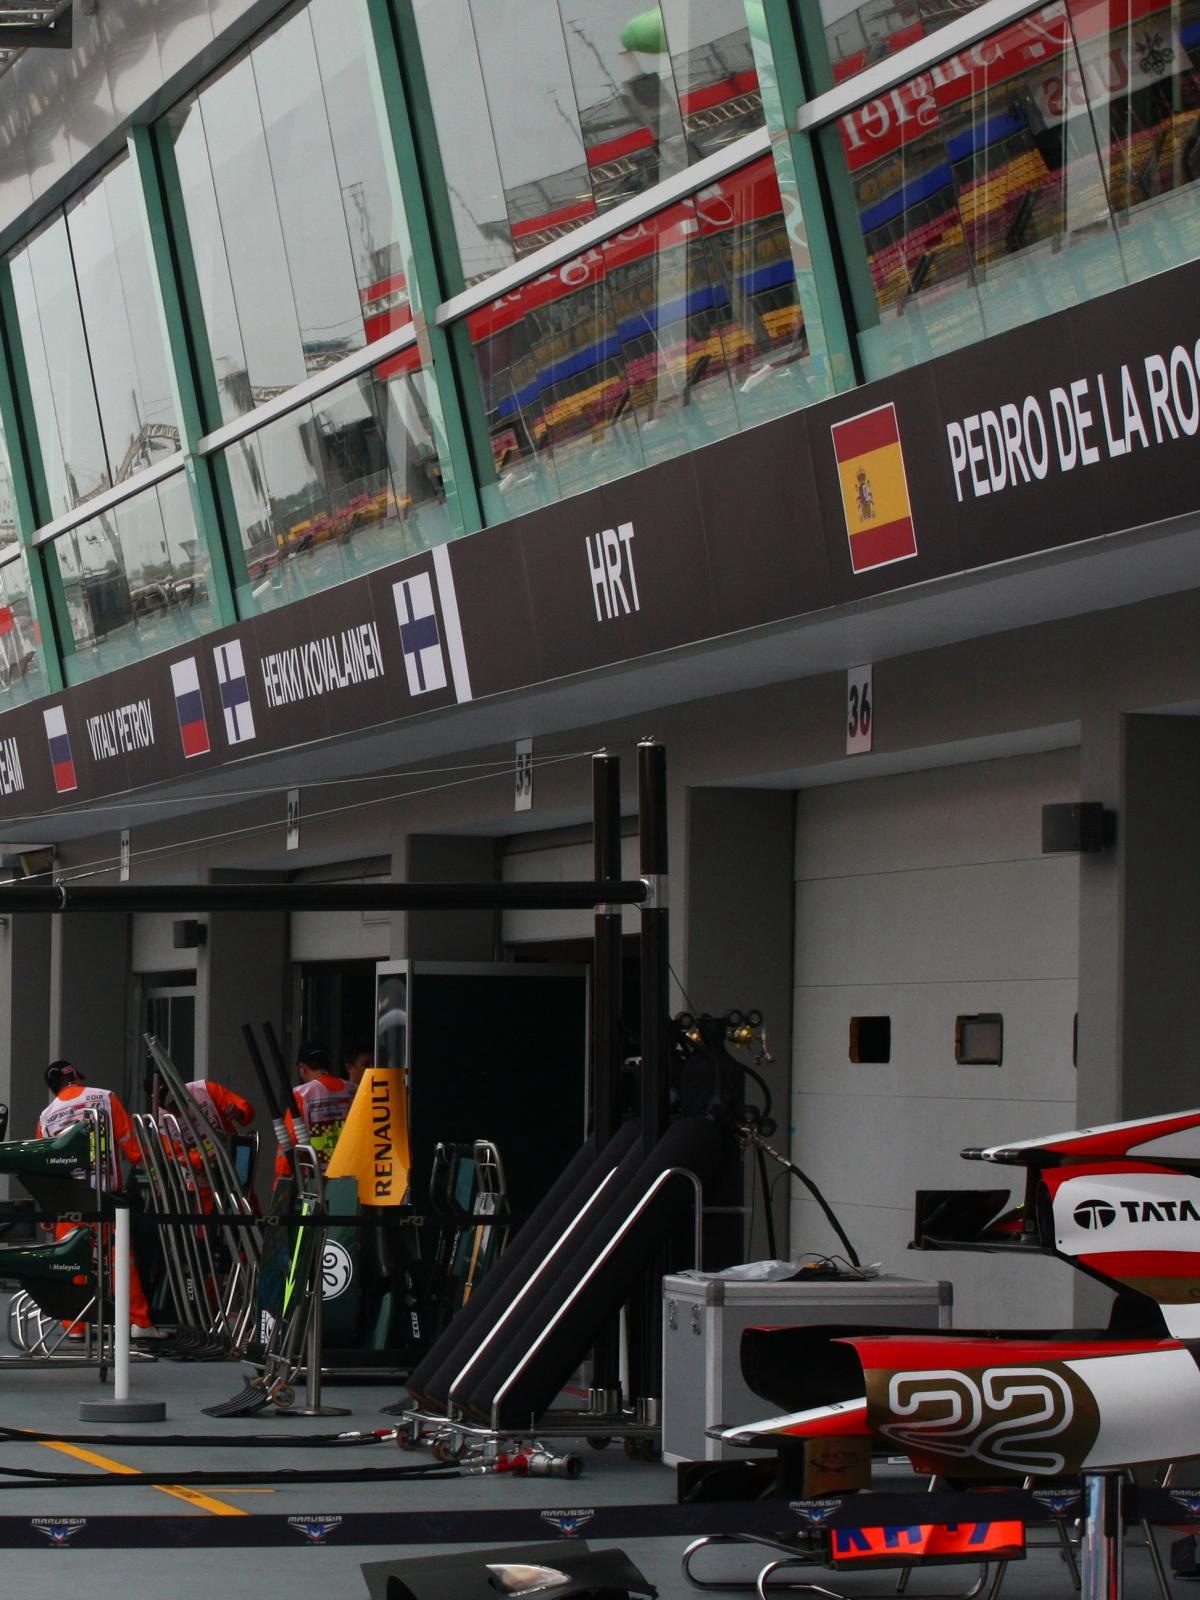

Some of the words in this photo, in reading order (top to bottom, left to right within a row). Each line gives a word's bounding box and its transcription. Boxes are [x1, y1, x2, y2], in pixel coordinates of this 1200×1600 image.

[947, 395, 1048, 502] PEDRO
[1050, 378, 1100, 472] DE
[1097, 364, 1149, 458] LA
[585, 521, 640, 622] HRT
[261, 648, 302, 708] HEIKKI
[300, 621, 384, 700] KOVALAINEN
[86, 711, 119, 761] VITALY
[117, 698, 155, 753] PETROV
[849, 683, 871, 738] 36
[371, 1075, 394, 1197] RENAULT
[1120, 1200, 1200, 1223] TATA
[287, 1515, 343, 1523] MARUSSIA
[540, 1509, 595, 1517] MARUSSIA
[789, 1499, 842, 1508] MARUSSIA
